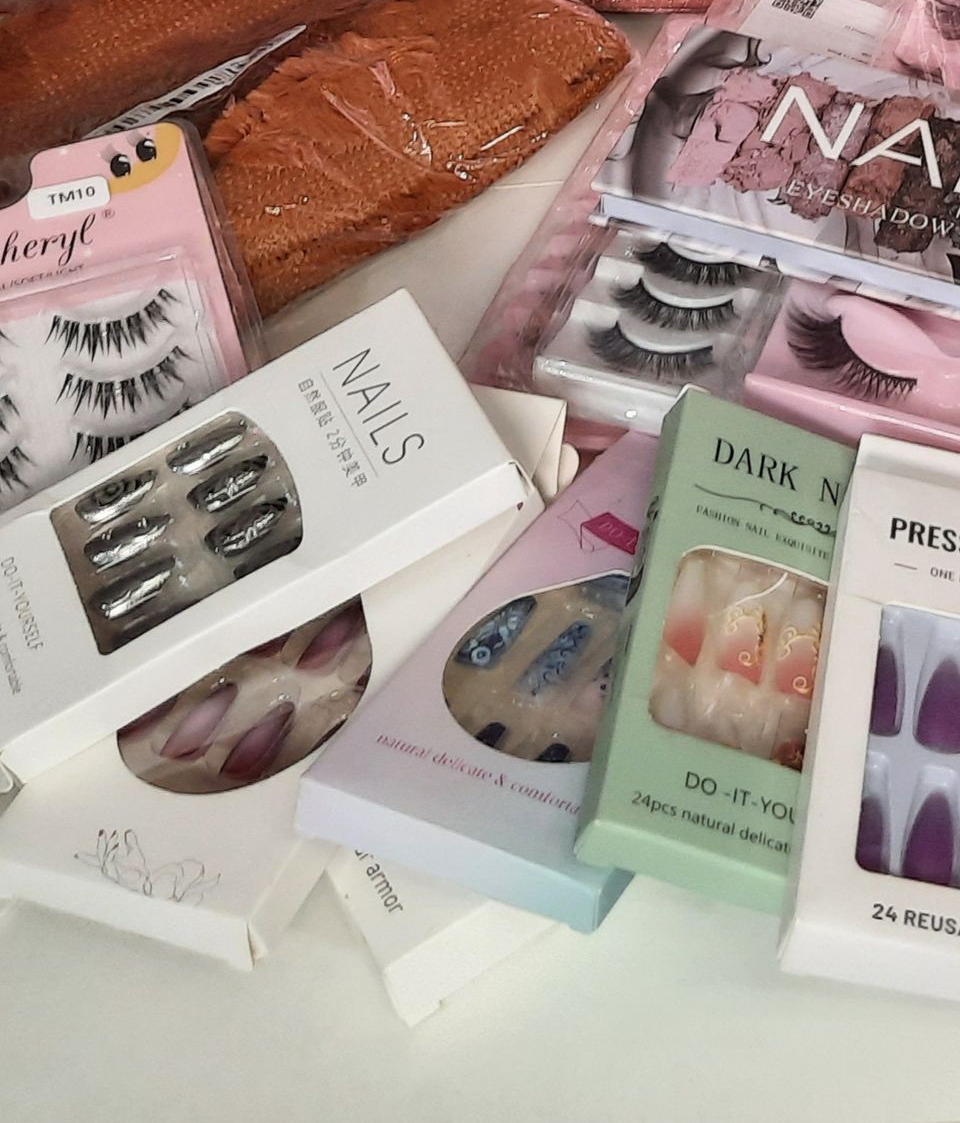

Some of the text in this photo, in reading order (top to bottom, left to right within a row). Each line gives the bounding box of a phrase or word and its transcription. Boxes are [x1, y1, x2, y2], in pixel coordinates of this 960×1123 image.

[48, 186, 95, 205] TM10
[786, 179, 953, 237] EYESHADOW
[332, 348, 425, 464] NAILS
[713, 437, 799, 492] DARK
[696, 504, 742, 528] FASHION
[775, 533, 831, 560] EXQUISITE
[930, 566, 955, 582] ONE
[377, 734, 432, 758] natural
[432, 752, 492, 780] delicate
[494, 773, 507, 787] &
[685, 771, 718, 796] DO
[631, 790, 793, 854] 24pcs natural delicat
[366, 863, 404, 914] armor
[871, 902, 898, 923] 24
